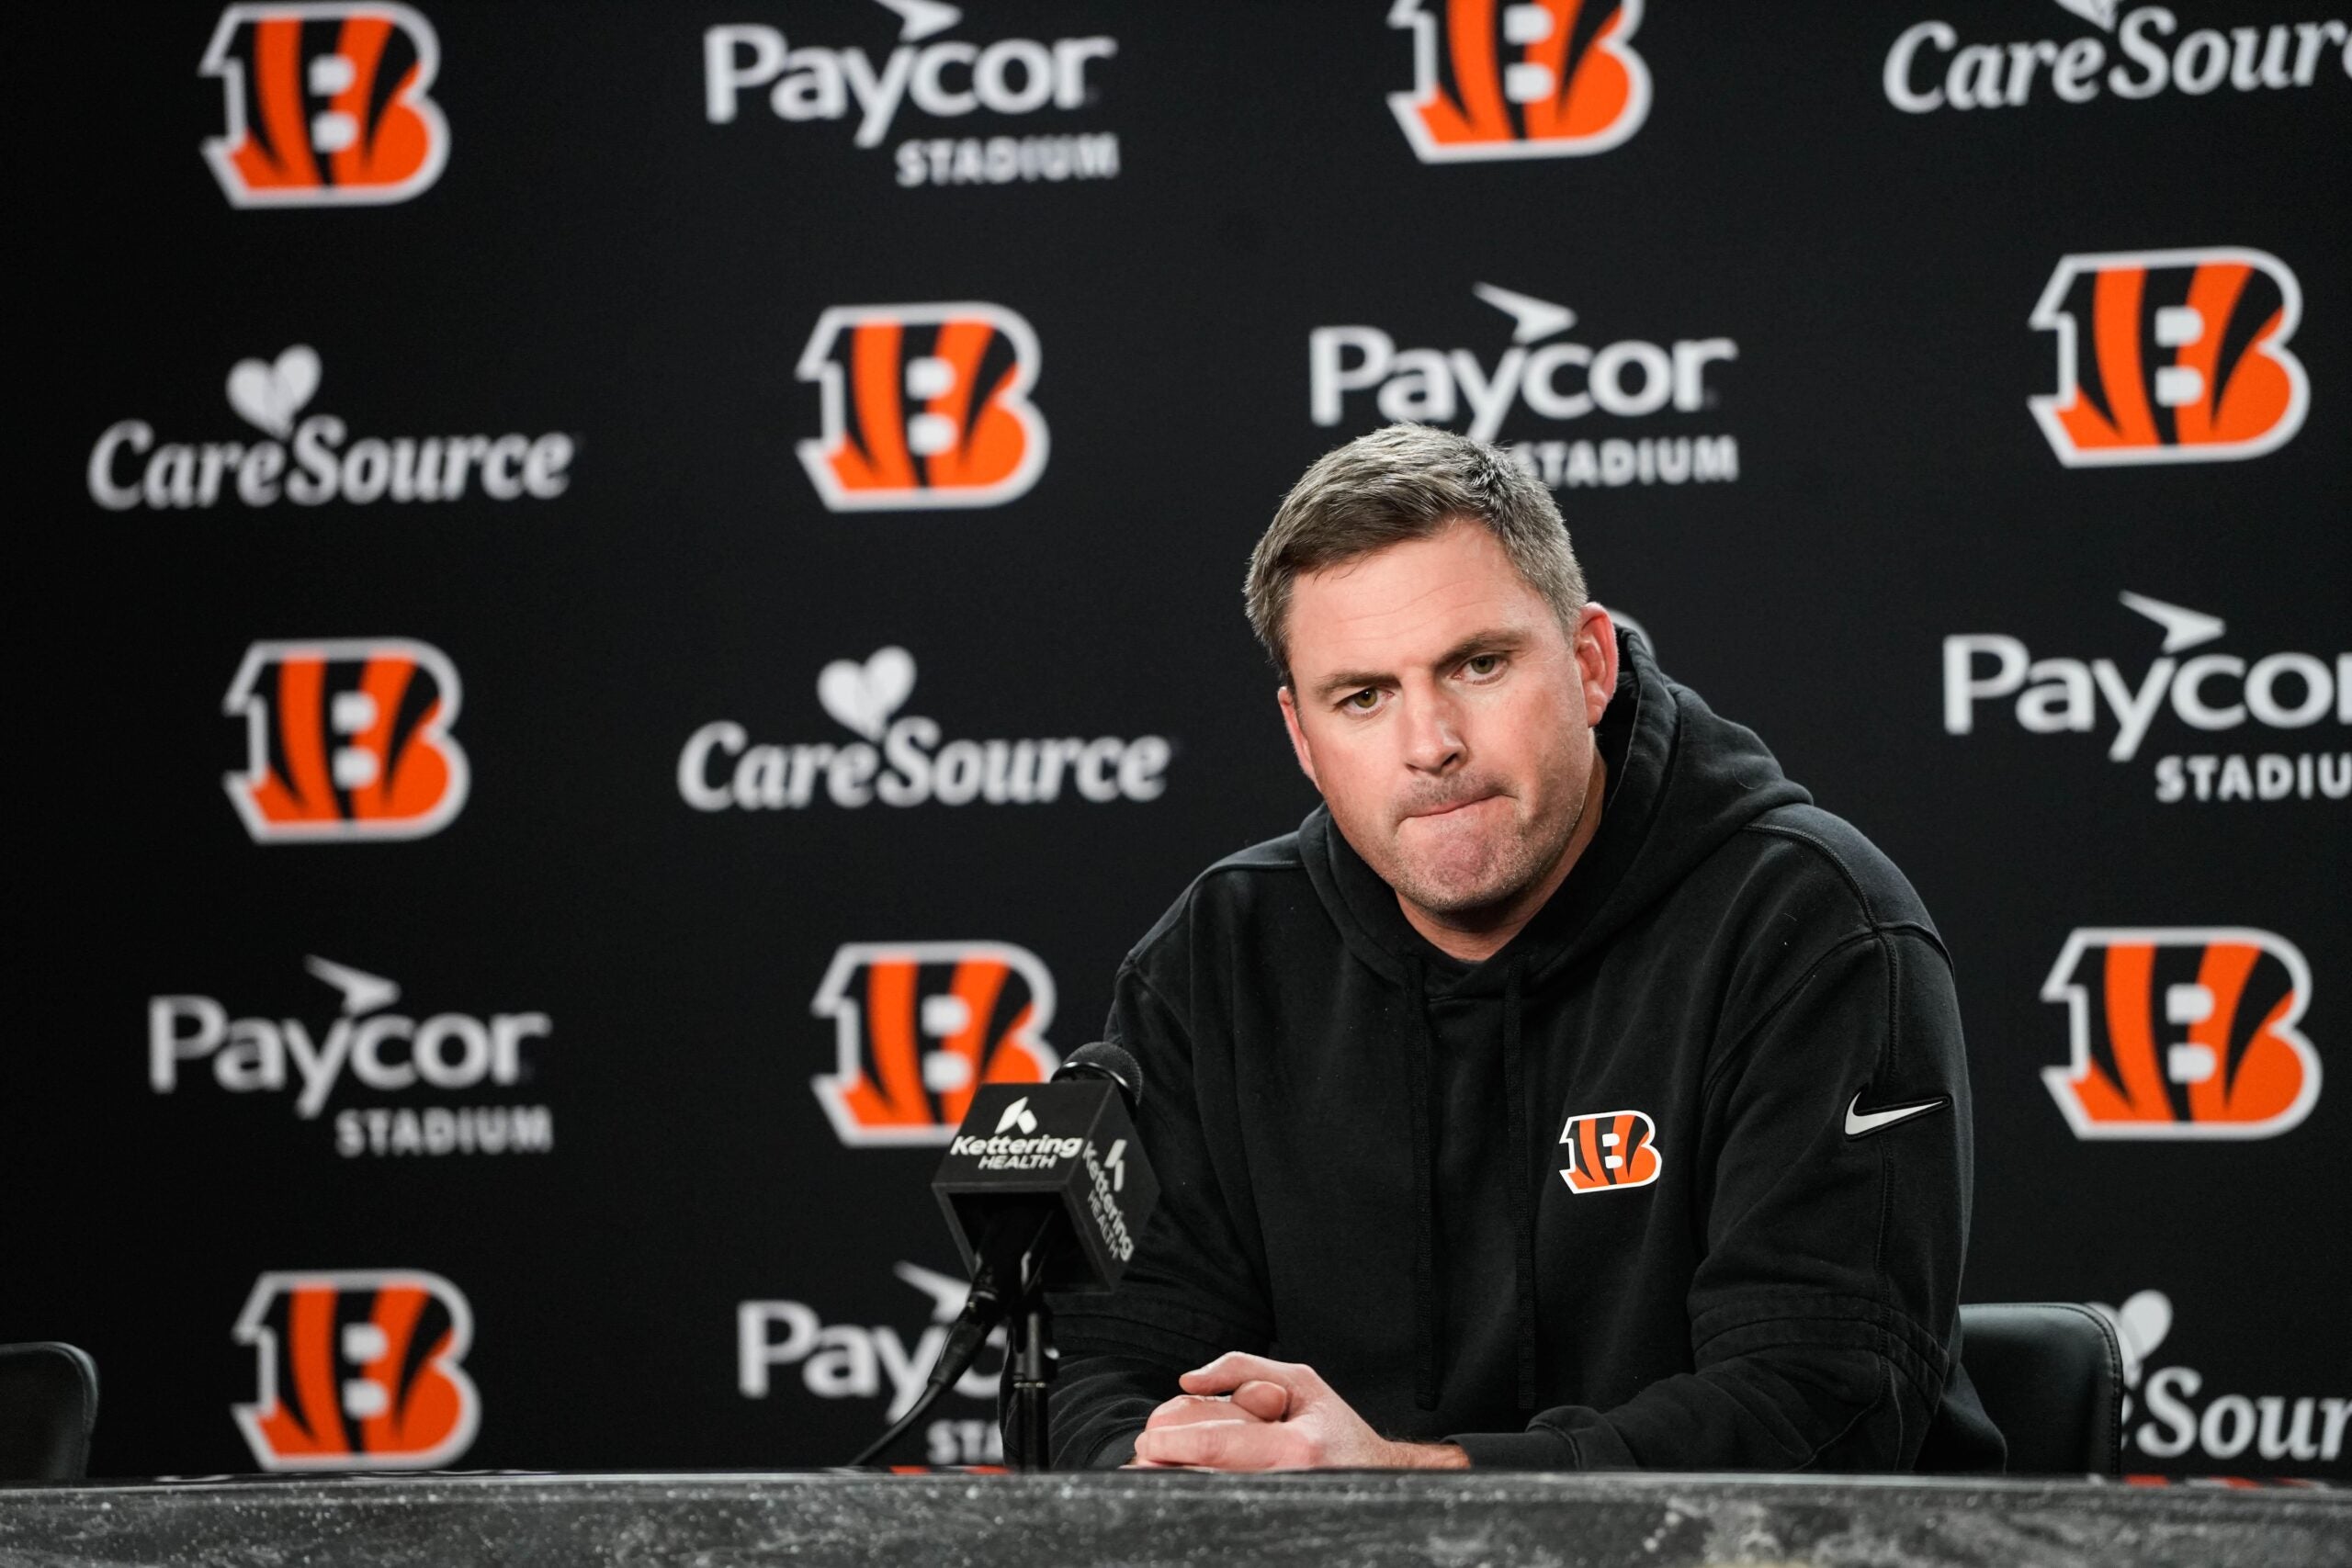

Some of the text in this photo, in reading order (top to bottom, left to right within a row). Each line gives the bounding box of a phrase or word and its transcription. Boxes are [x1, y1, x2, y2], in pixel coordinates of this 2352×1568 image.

[704, 23, 1119, 149] Paycor
[895, 132, 1119, 187] STADIUM
[1309, 324, 1739, 445] Paycor
[88, 413, 574, 510] CareSource
[676, 716, 1171, 812] CareSource
[149, 995, 553, 1119] Paycor
[337, 1107, 552, 1155] STADIUM
[950, 1134, 1084, 1158] Kettering
[977, 1155, 1057, 1170] HEALTH
[1082, 1140, 1135, 1262] Kettering
